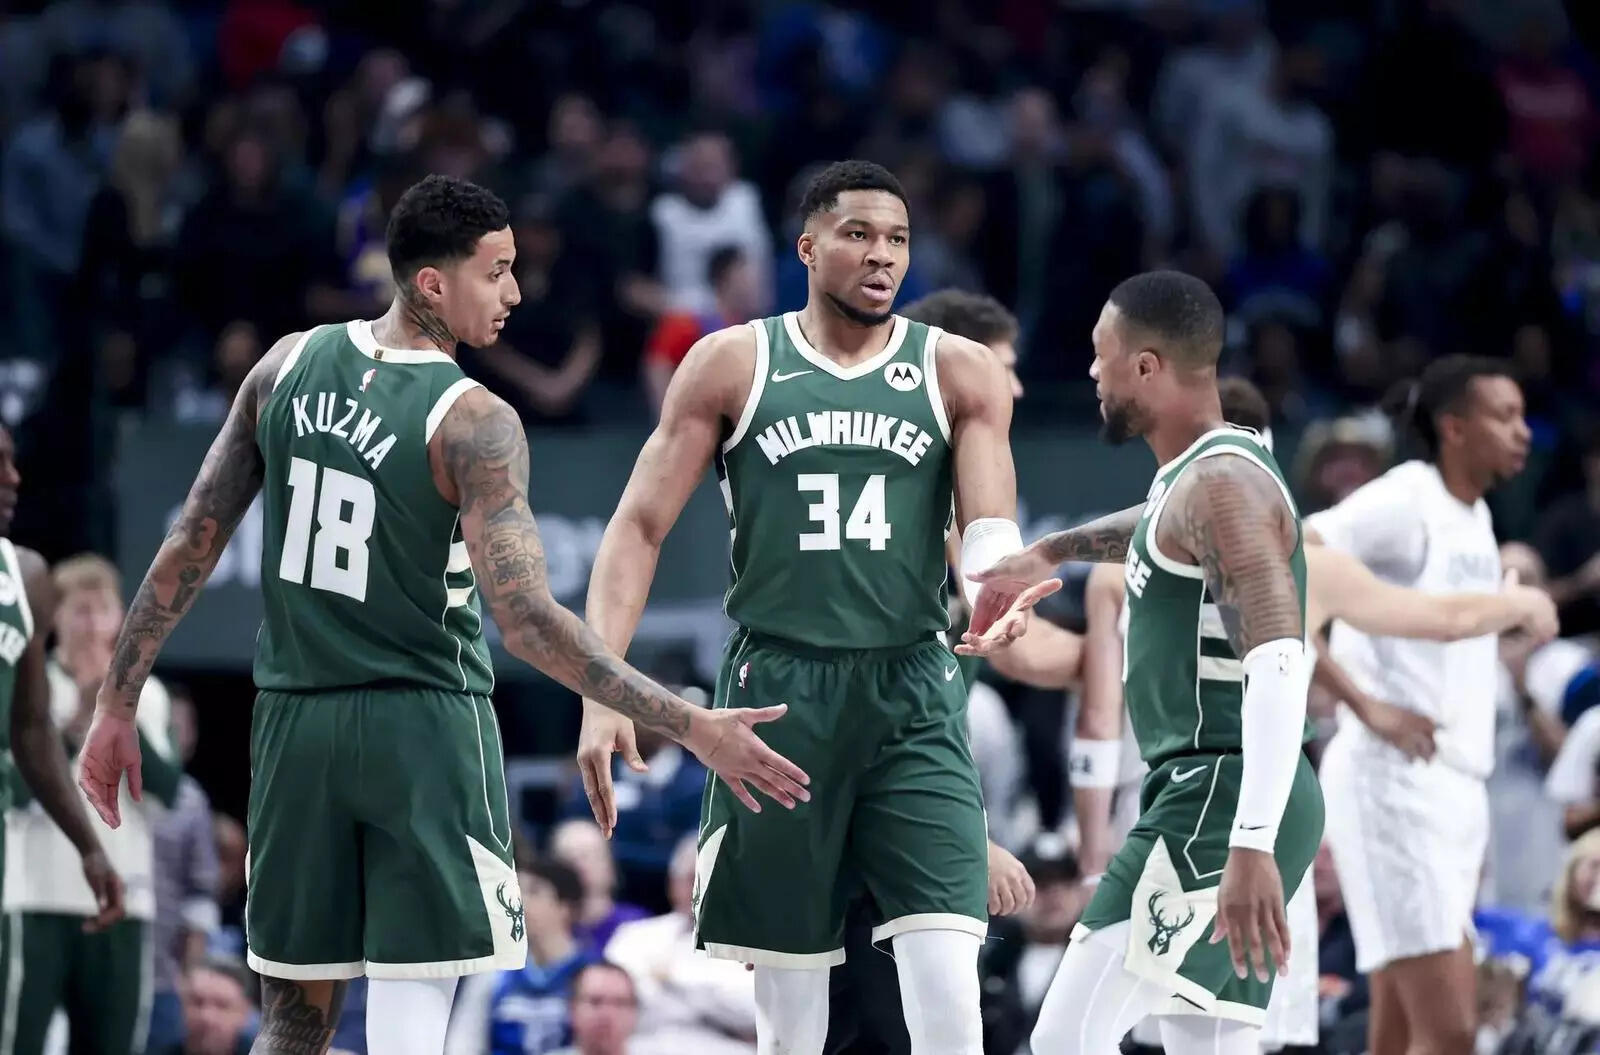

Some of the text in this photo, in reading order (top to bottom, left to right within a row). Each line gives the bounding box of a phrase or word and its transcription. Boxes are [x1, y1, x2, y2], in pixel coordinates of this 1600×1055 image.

[293, 392, 397, 470] KUZMA
[755, 411, 933, 467] MILWAUKEE
[279, 457, 376, 602] 18
[797, 474, 891, 551] 34
